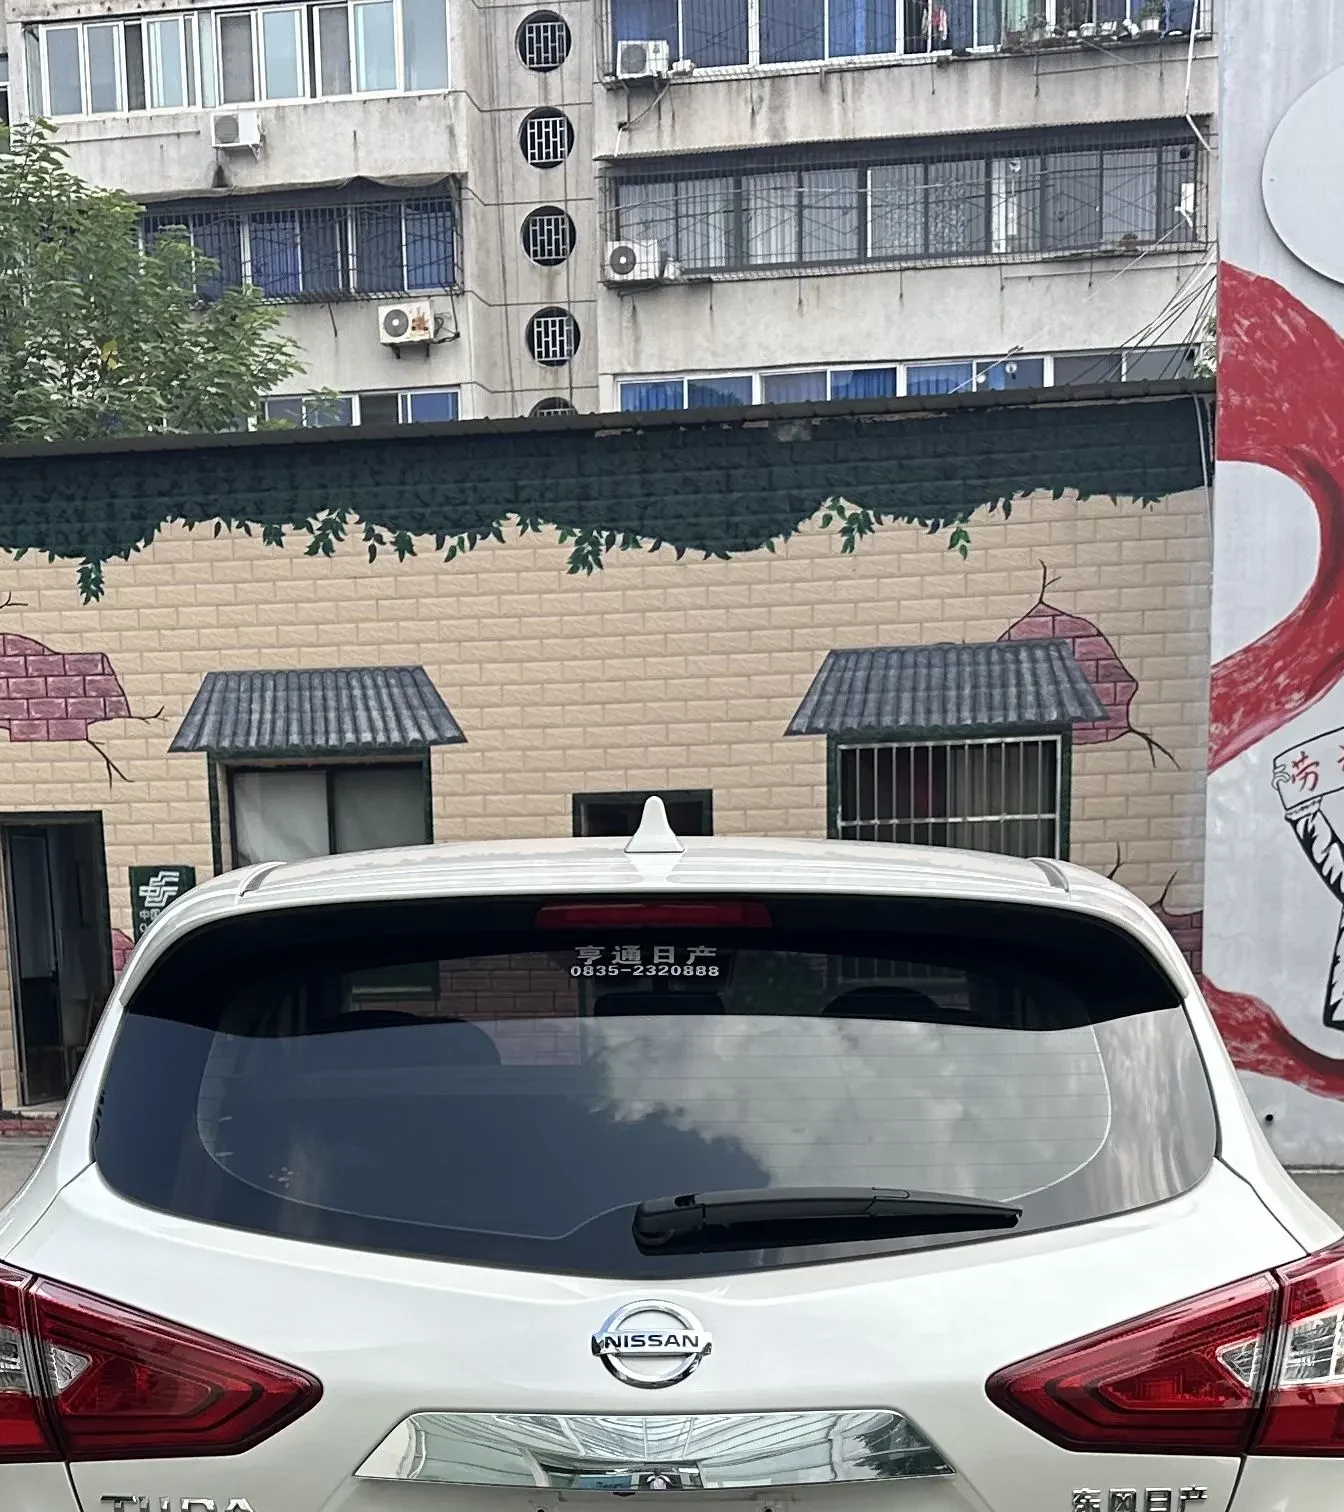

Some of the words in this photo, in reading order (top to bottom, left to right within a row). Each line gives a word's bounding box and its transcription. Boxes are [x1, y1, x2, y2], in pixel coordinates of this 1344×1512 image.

[574, 945, 718, 965] 亨通日产
[570, 965, 720, 977] 0835-2320888
[605, 1334, 699, 1348] NISSAN
